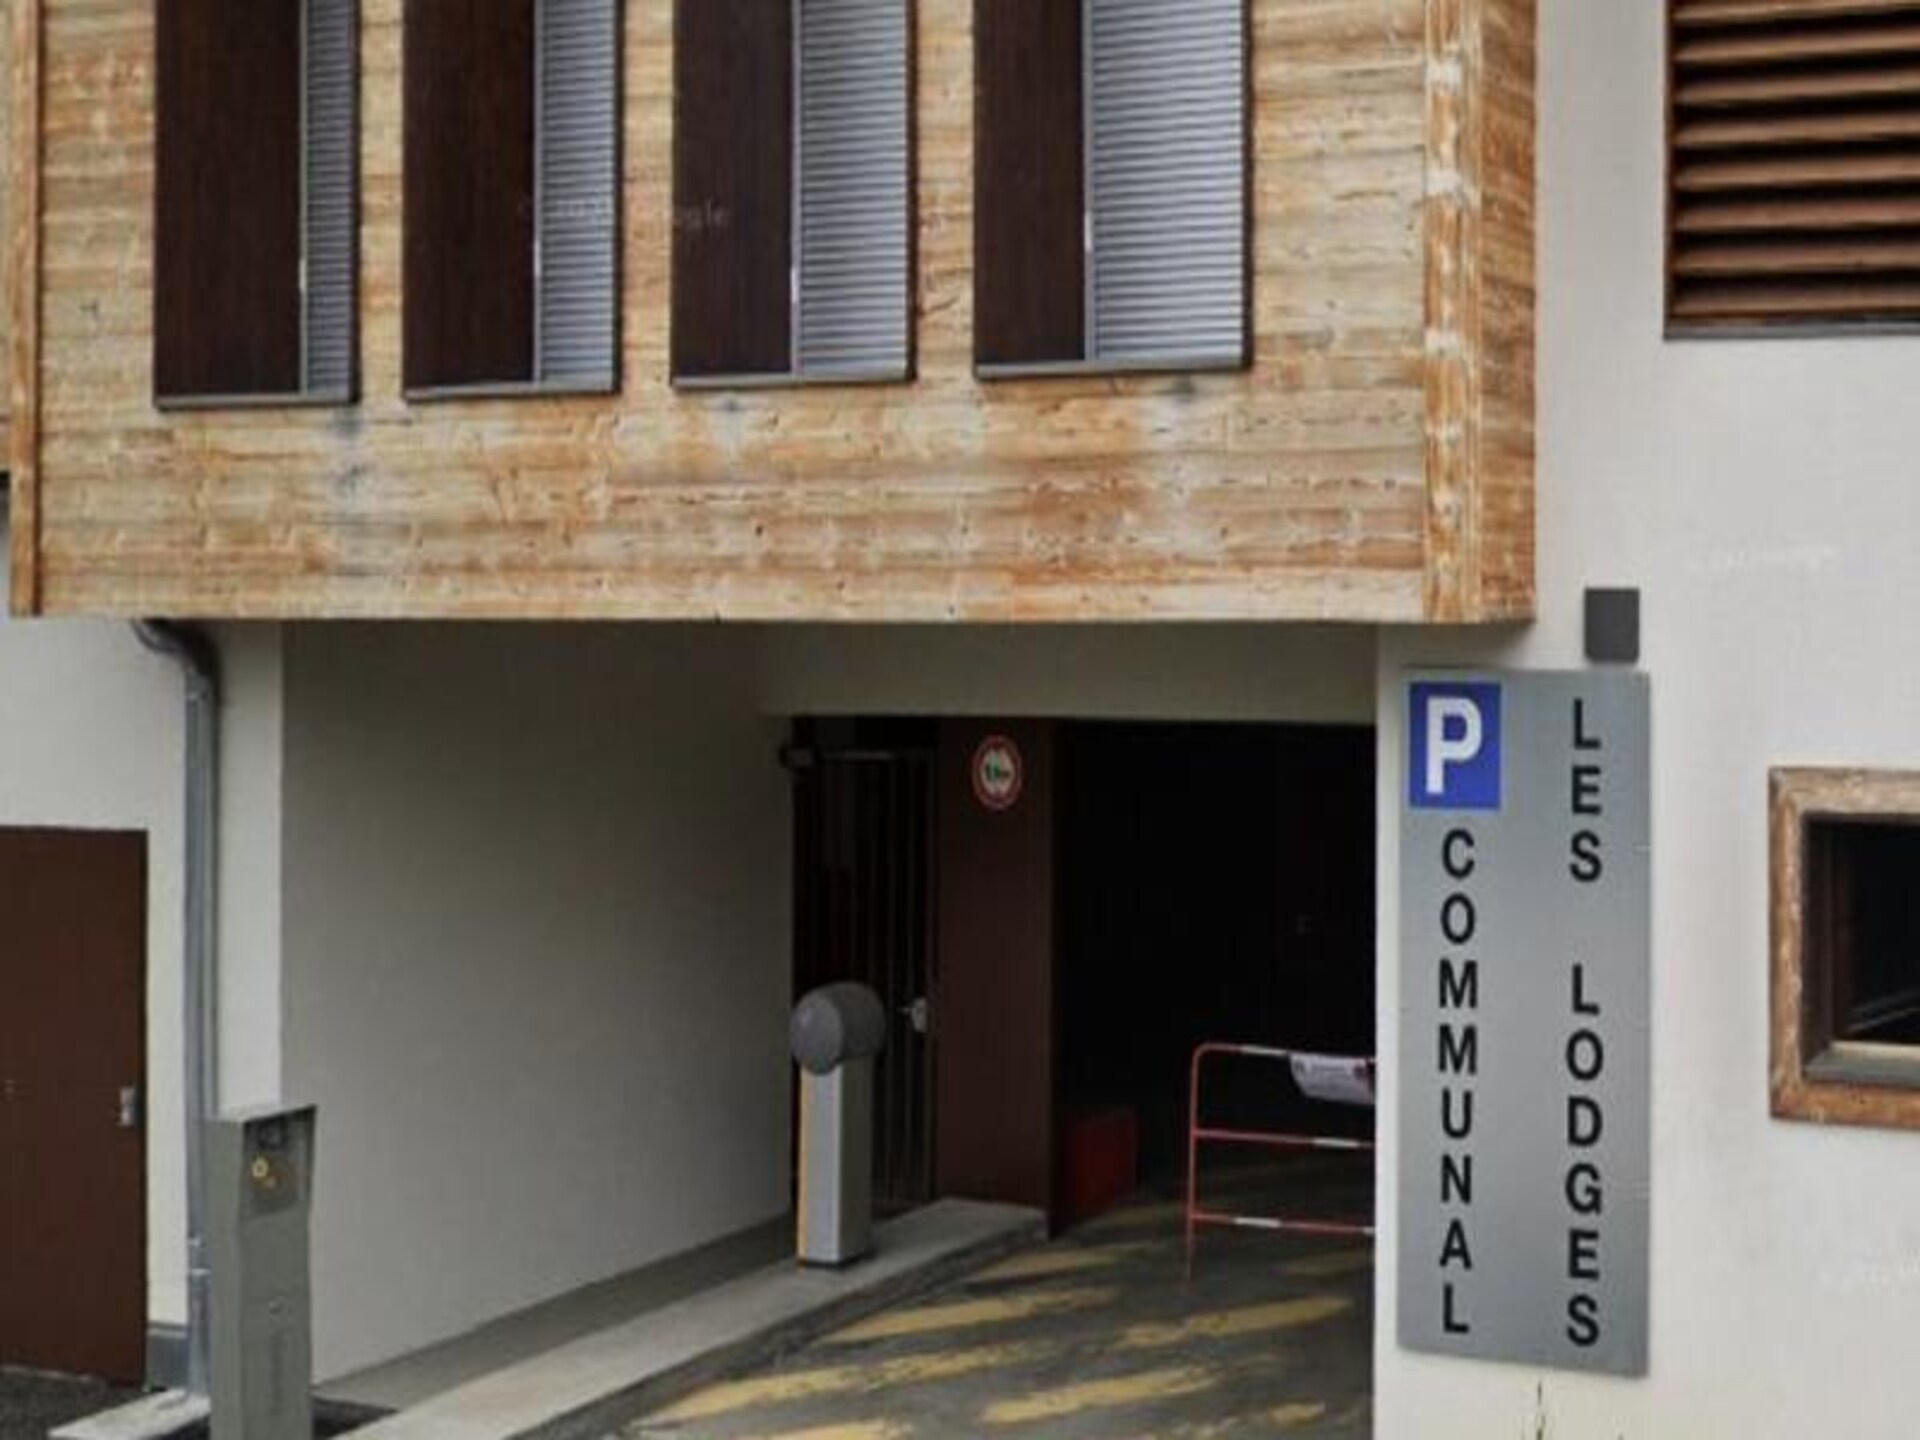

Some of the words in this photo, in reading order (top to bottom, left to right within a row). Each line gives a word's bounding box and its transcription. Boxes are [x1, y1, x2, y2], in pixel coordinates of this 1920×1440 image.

[1426, 698, 1482, 794] P
[1570, 697, 1602, 882] LES
[1438, 828, 1478, 1335] COMMUNAL
[1565, 964, 1604, 1347] LODGES
